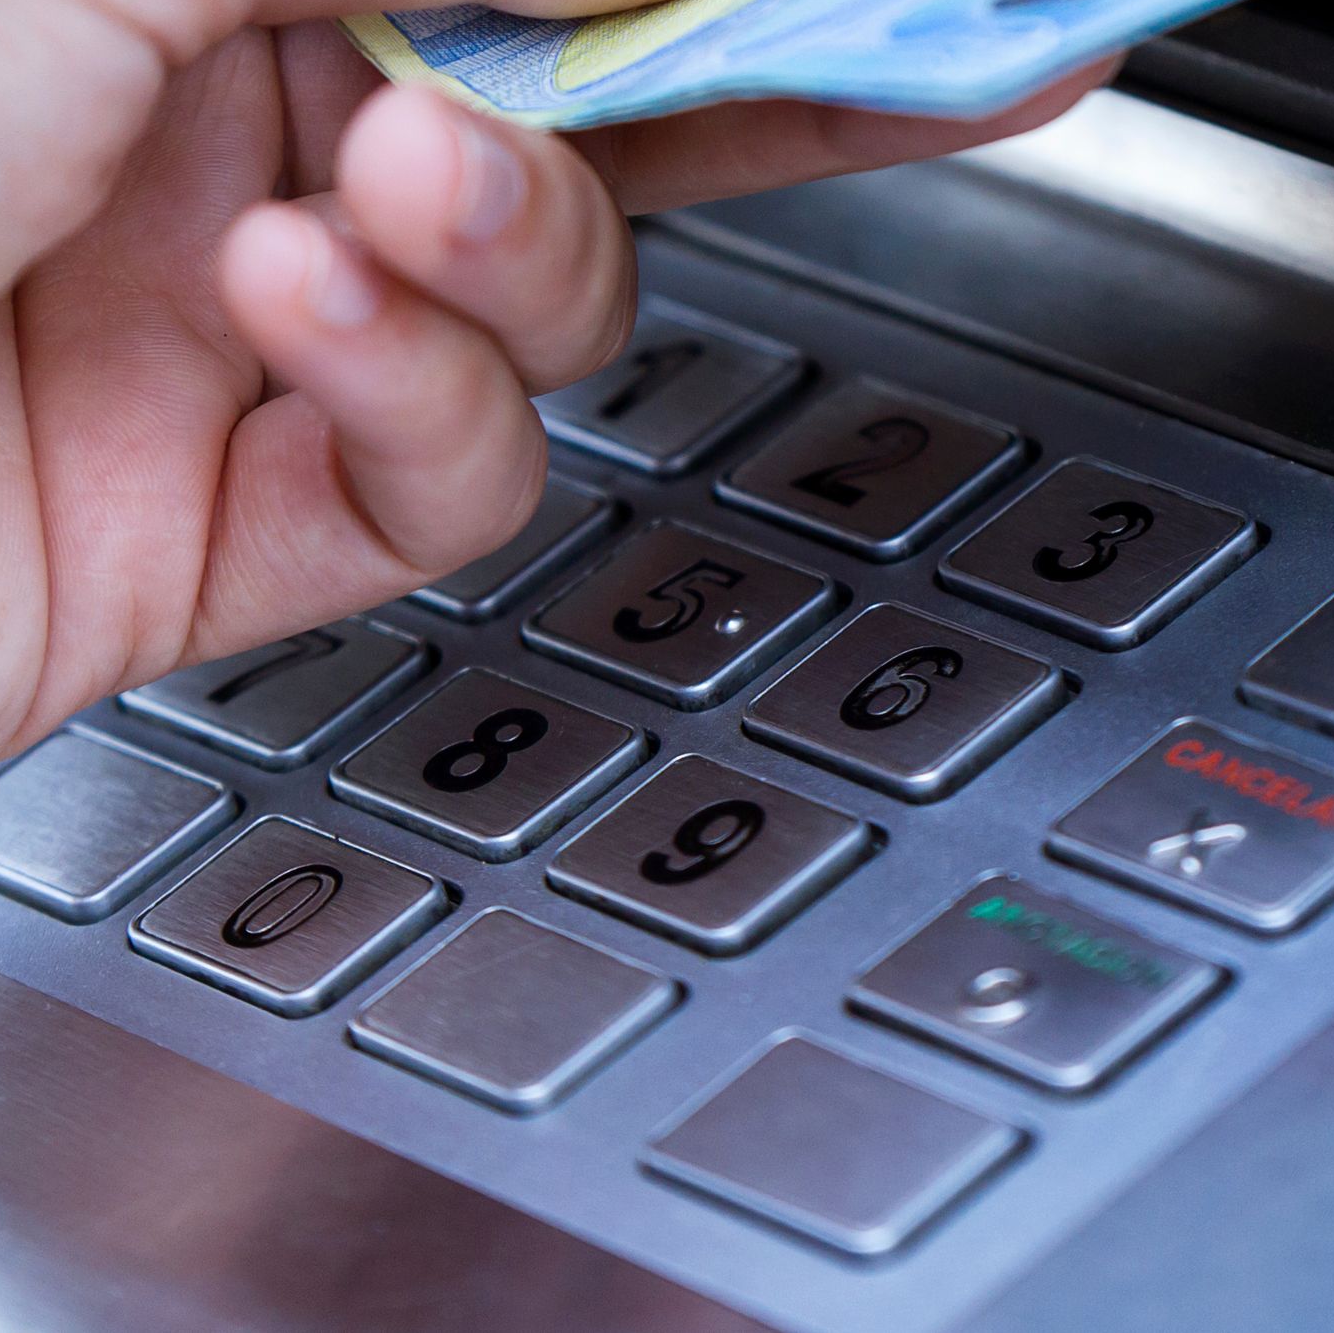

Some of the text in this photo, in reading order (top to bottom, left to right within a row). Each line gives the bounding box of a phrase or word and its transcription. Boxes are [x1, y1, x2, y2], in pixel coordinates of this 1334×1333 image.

[600, 339, 704, 420] 1
[790, 418, 929, 507] 2
[1033, 501, 1154, 582] 3
[613, 559, 746, 643] 5
[207, 629, 345, 703] 7
[840, 646, 963, 730] 6
[423, 708, 548, 793] 8
[640, 799, 765, 884] 9
[222, 865, 344, 946] 0
